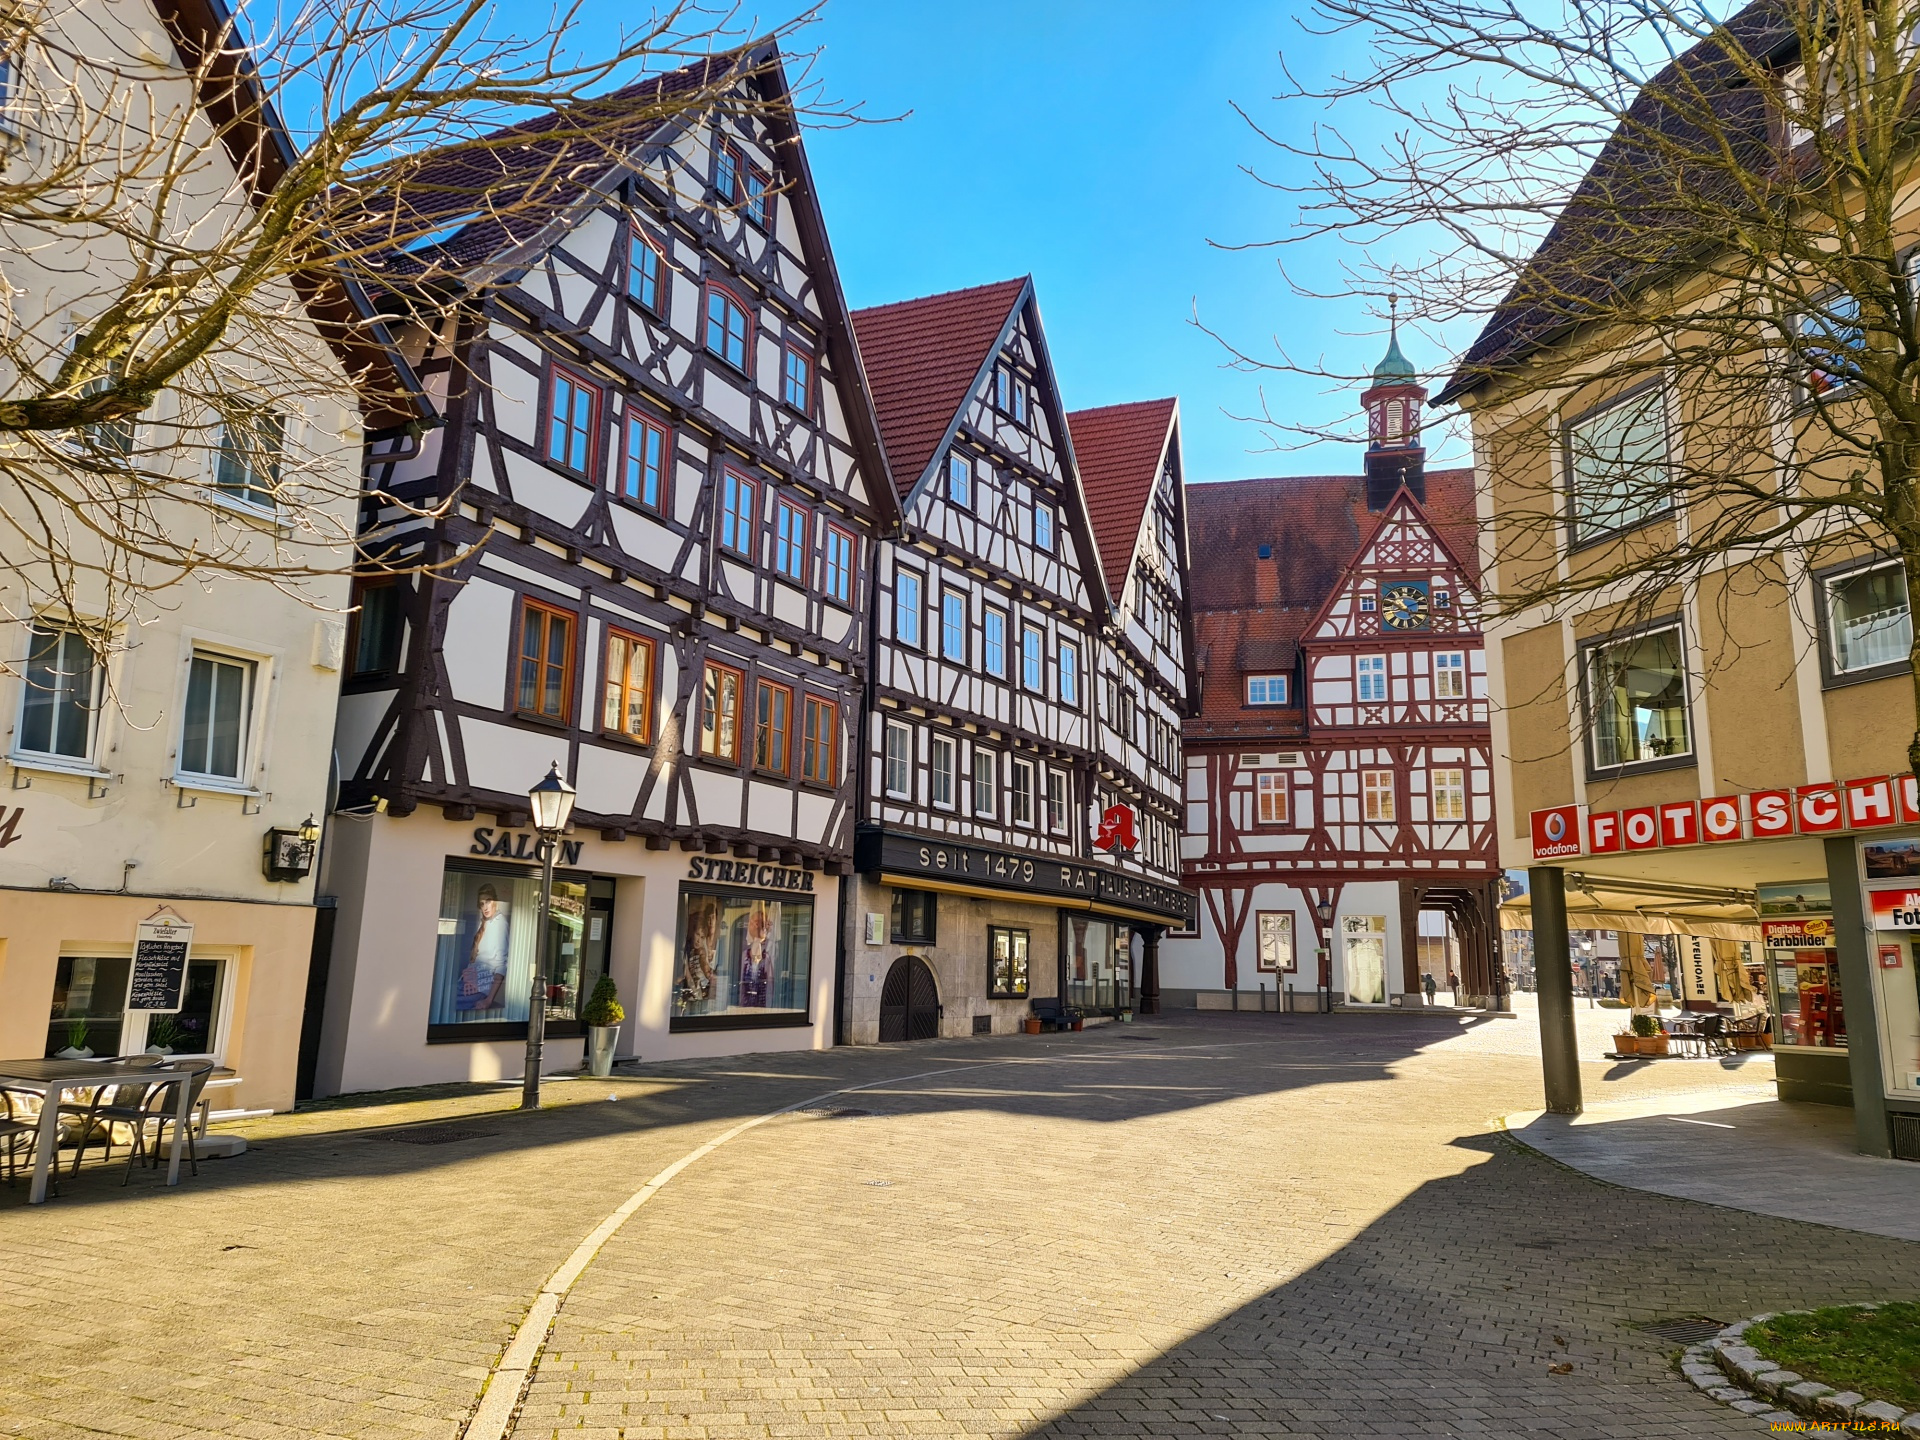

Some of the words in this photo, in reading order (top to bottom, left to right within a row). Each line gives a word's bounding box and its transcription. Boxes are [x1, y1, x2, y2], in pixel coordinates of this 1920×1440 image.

[1593, 802, 1737, 846] FOTO
[1535, 843, 1578, 856] vodafone
[688, 856, 815, 892] STREICHER
[919, 847, 970, 873] seit
[984, 853, 1035, 883] 1479
[1060, 866, 1188, 913] RATHAUS-APOTHEKE
[1766, 934, 1827, 947] Farbbilder
[1768, 924, 1801, 935] Digitale
